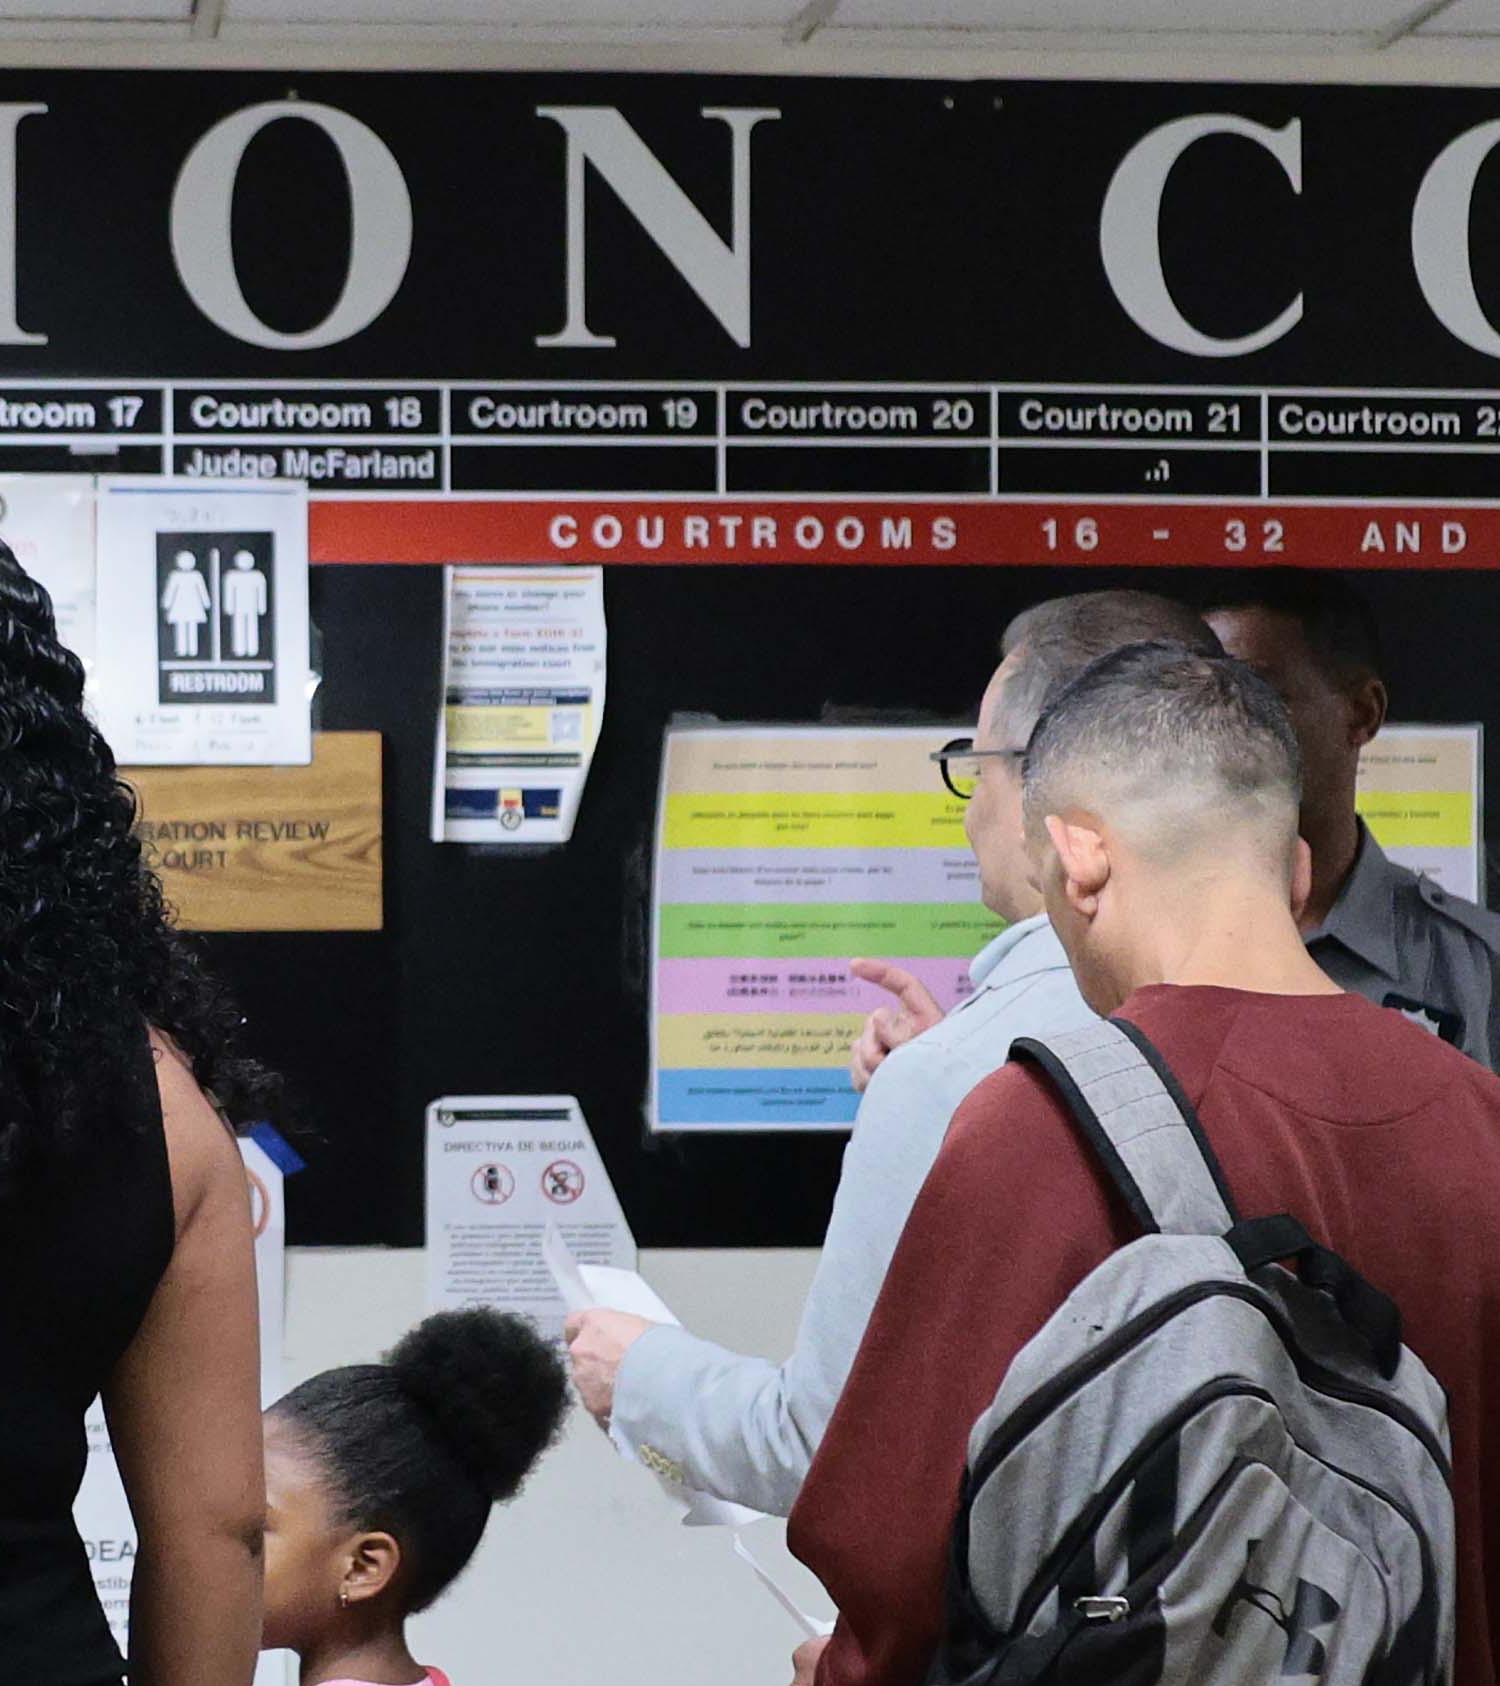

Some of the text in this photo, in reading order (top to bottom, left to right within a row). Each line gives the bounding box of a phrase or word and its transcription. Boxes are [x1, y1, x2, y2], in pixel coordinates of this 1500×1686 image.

[107, 396, 142, 426] 17
[191, 396, 421, 428] Courtroom 18
[469, 398, 697, 429] Courtroom 19
[742, 399, 973, 430] Courtroom 20
[1019, 401, 1241, 432] Courtroom 21
[1279, 406, 1460, 435] Courtroom
[186, 448, 434, 480] Judge McFarland
[550, 515, 957, 550] COURTROOMS
[1041, 518, 1098, 550] 16
[1224, 520, 1285, 552] 32
[1361, 521, 1467, 553] AND
[170, 671, 264, 692] RESTROOM
[236, 820, 330, 841] REVIEW
[146, 849, 229, 871] COURT
[444, 1140, 586, 1153] DIRECTIVA DE SEGUR
